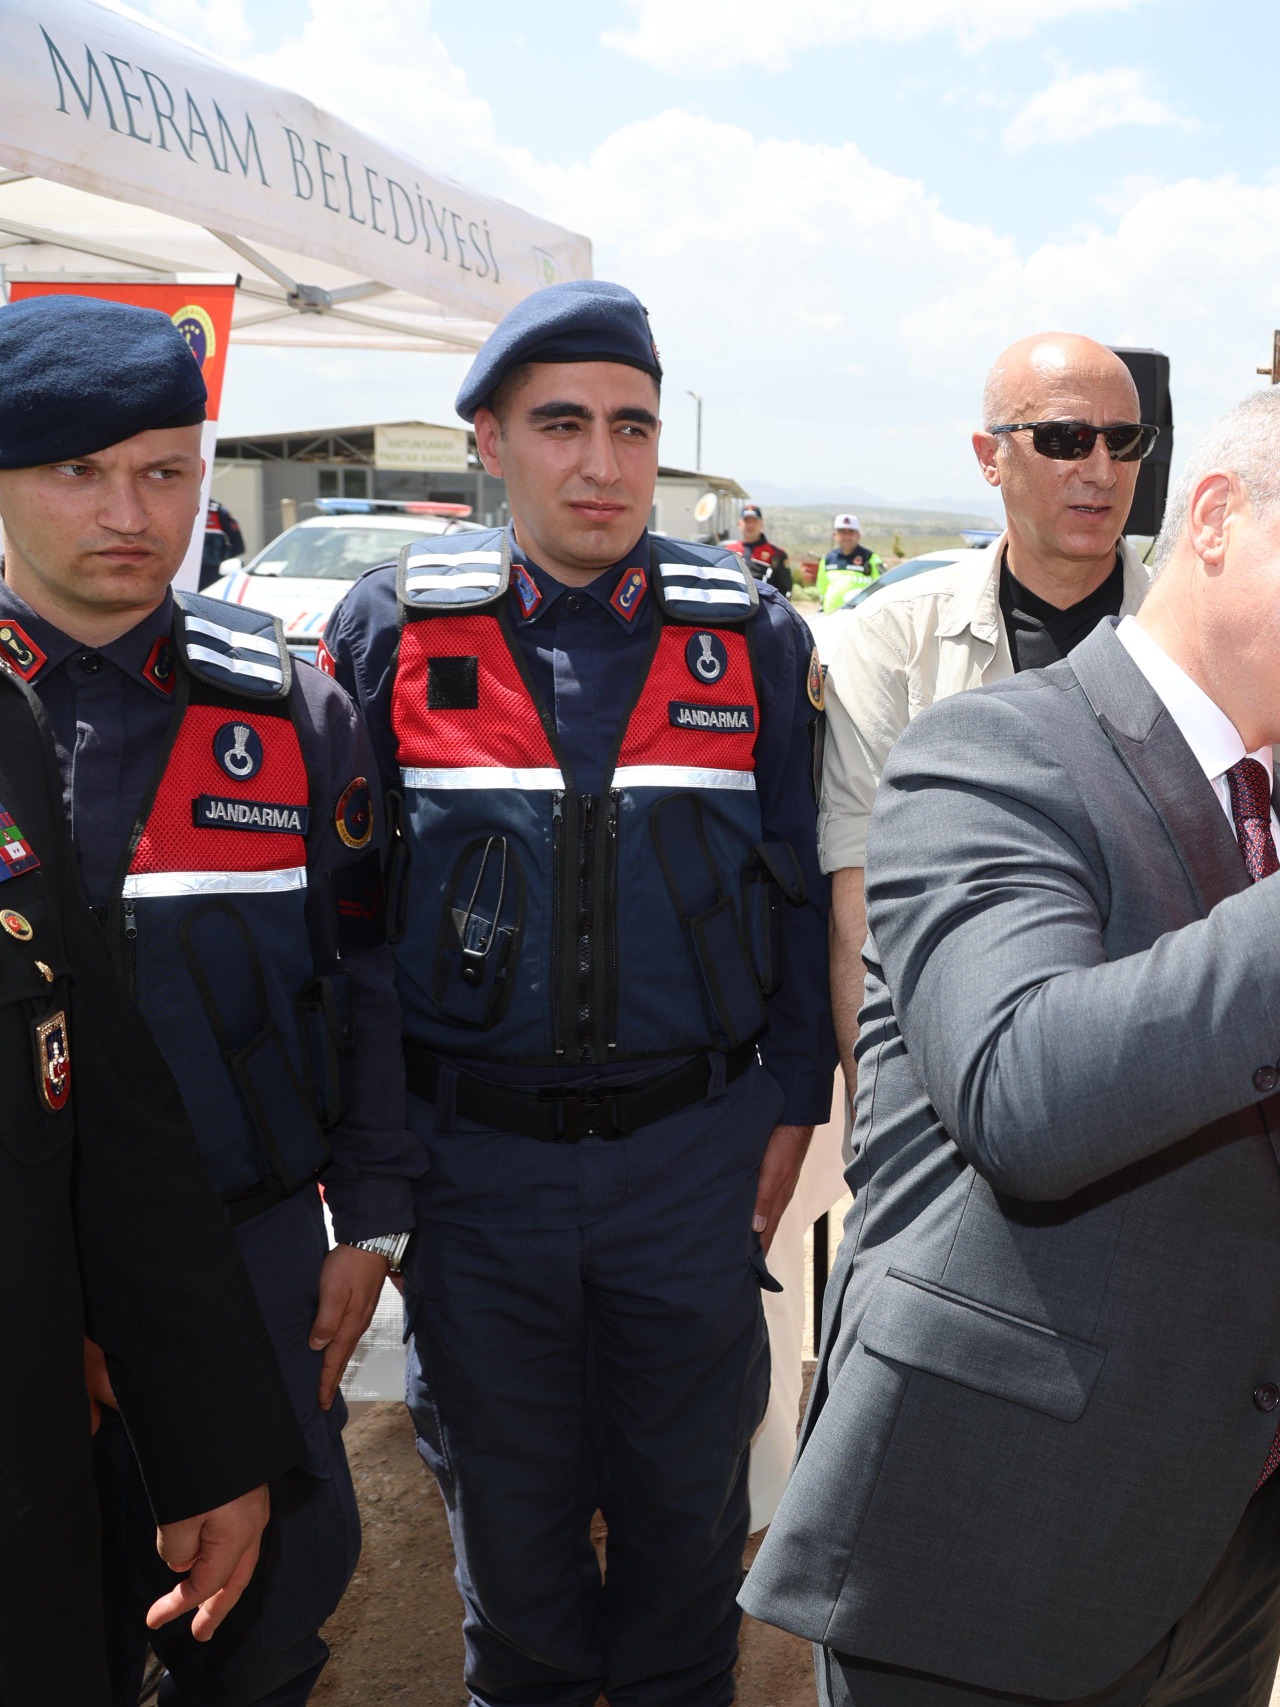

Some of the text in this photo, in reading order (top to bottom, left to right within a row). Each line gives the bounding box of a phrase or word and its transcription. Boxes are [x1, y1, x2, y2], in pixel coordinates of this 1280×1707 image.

[38, 23, 500, 284] MERAM BELEDİYESİ
[676, 708, 749, 728] JANDARMA
[205, 801, 302, 830] JANDARMA
